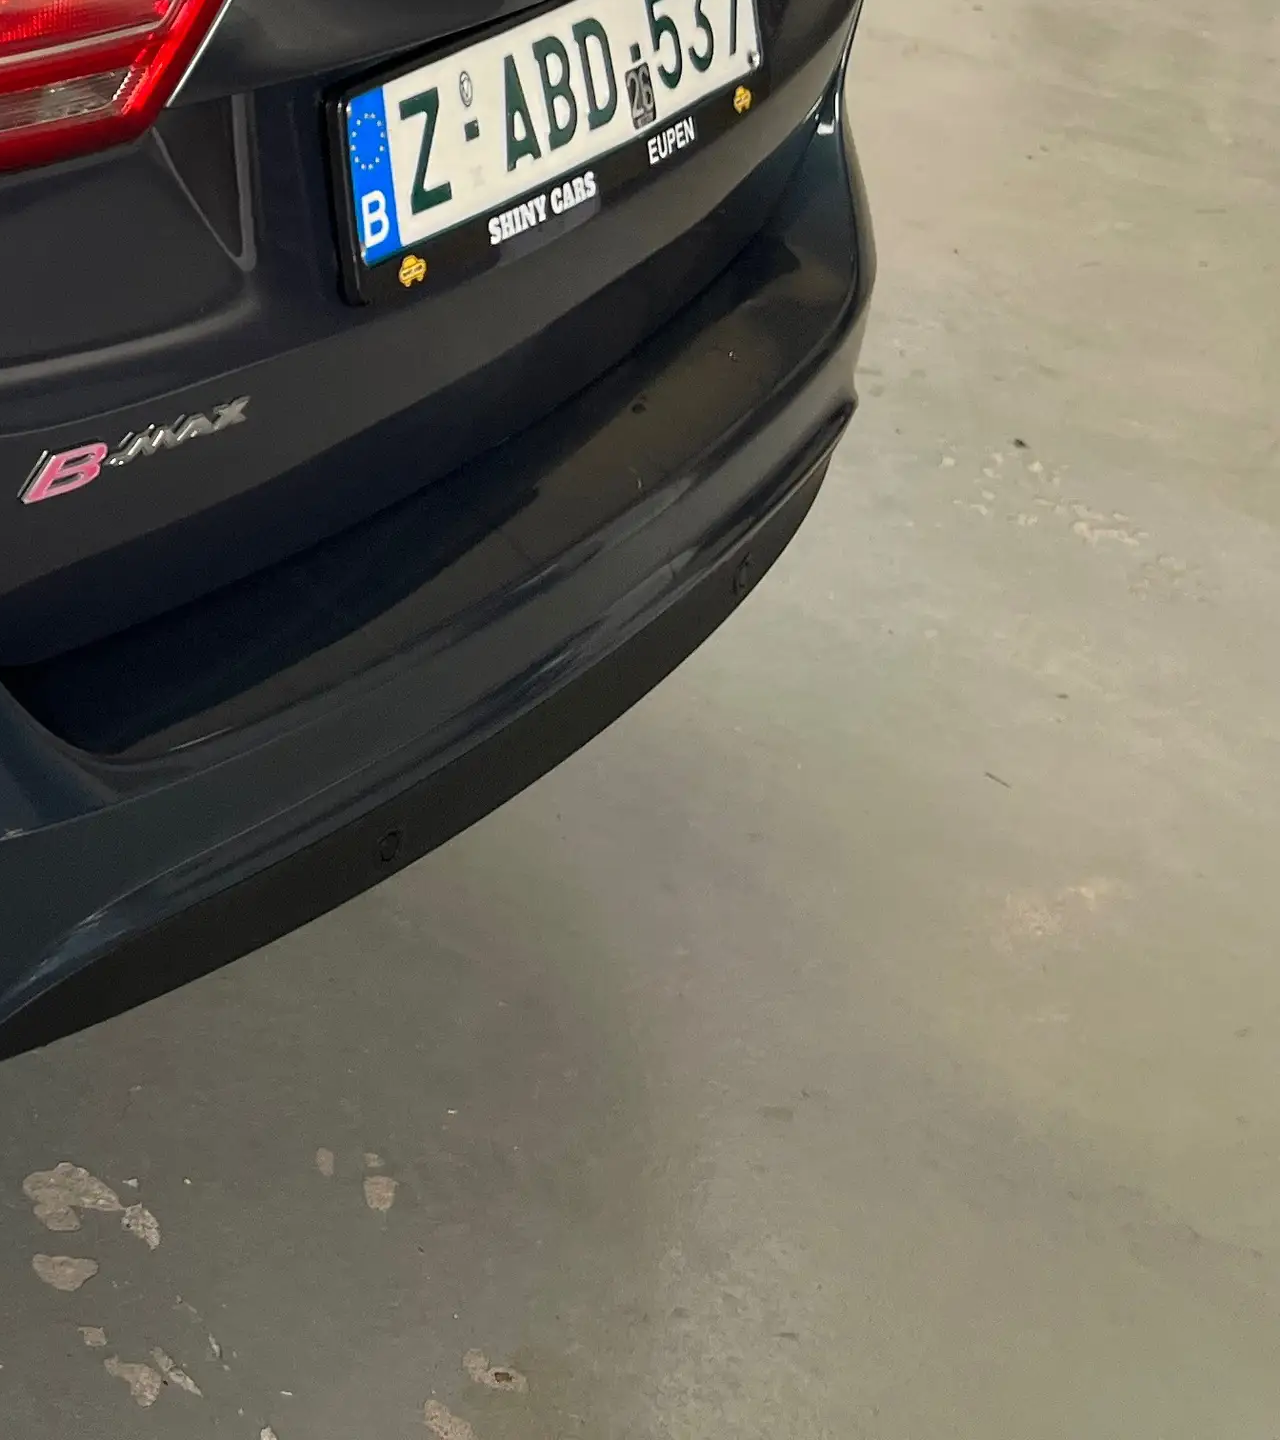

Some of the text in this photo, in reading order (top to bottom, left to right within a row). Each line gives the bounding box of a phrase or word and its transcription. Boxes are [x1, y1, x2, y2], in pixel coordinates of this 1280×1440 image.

[647, 116, 696, 165] EUPEN
[360, 189, 390, 247] B
[488, 171, 597, 246] SHINY CARS
